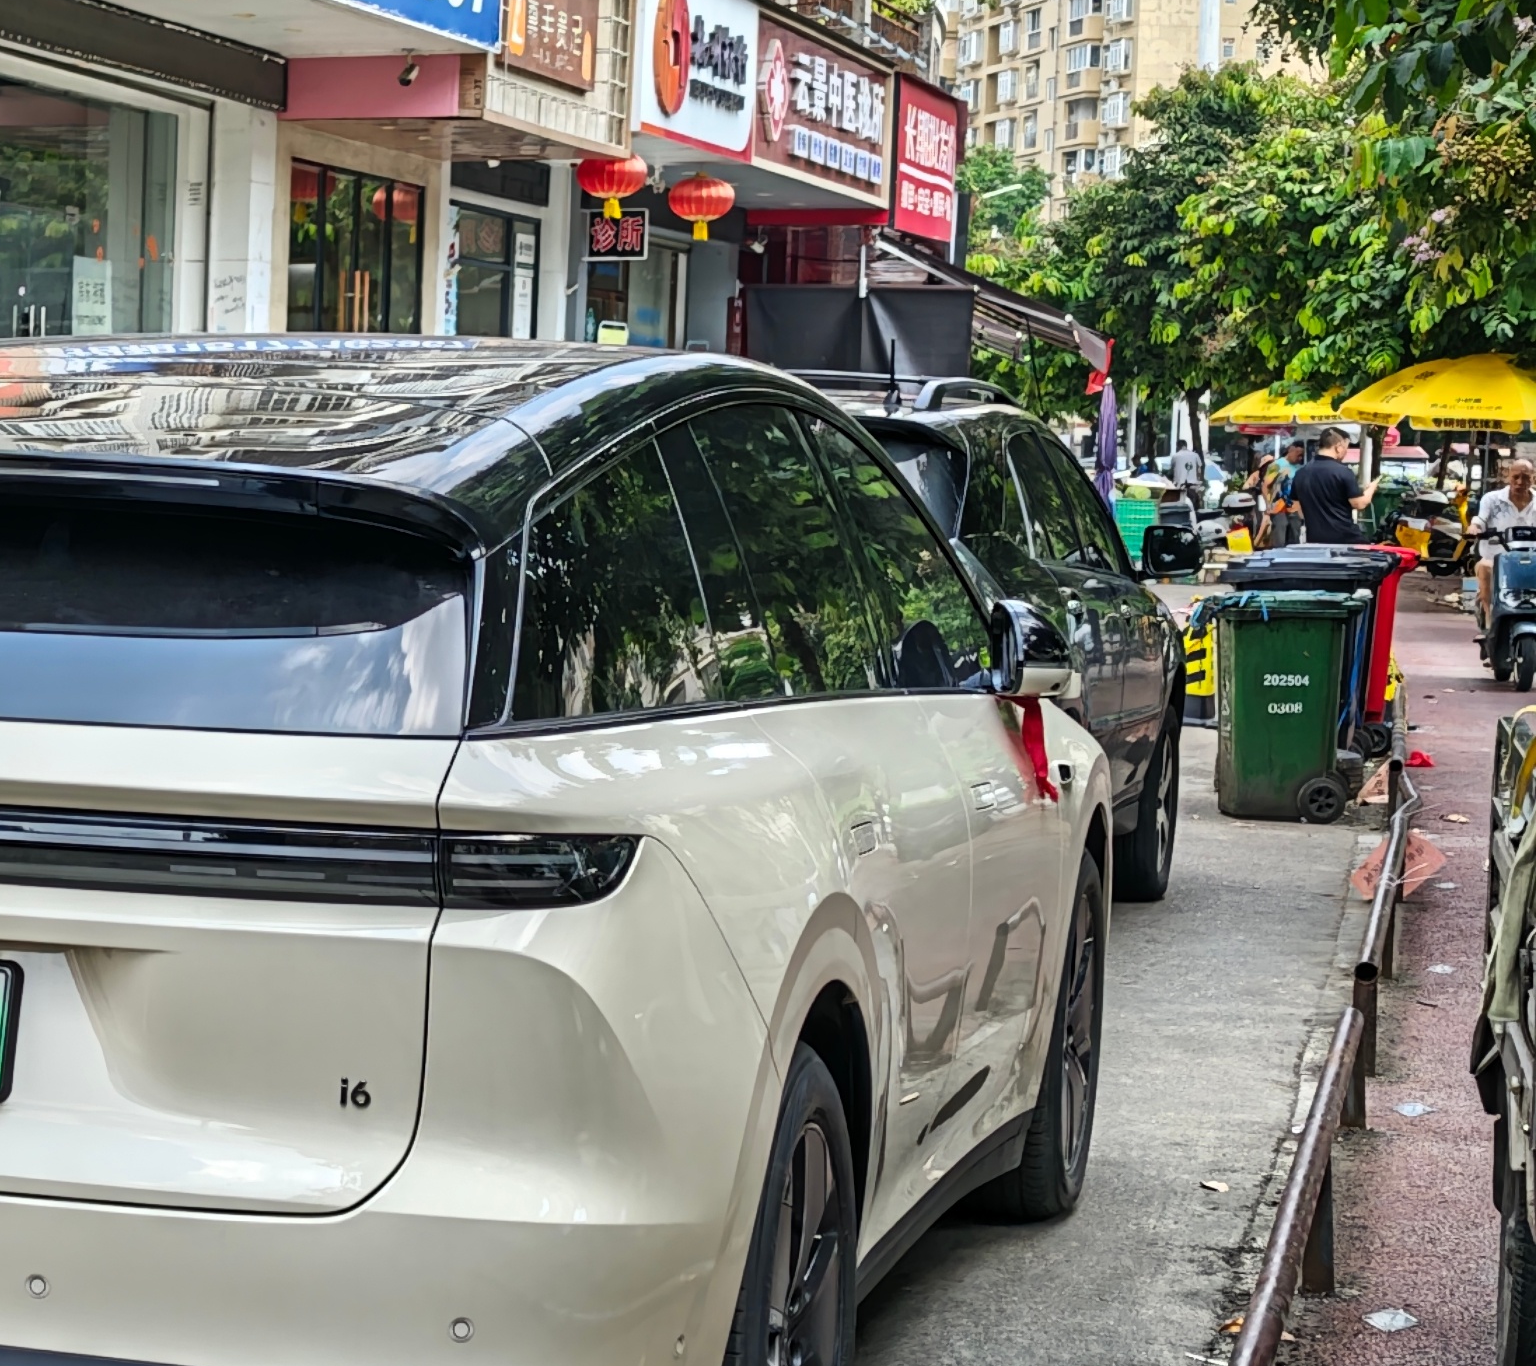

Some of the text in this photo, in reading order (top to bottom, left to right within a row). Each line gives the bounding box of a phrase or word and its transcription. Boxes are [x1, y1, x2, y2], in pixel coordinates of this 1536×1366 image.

[789, 51, 885, 146] 云景中医诊所
[590, 215, 644, 253] 诊所
[1263, 673, 1310, 687] 202504
[1267, 701, 1303, 715] 0308
[339, 1076, 372, 1110] i6
